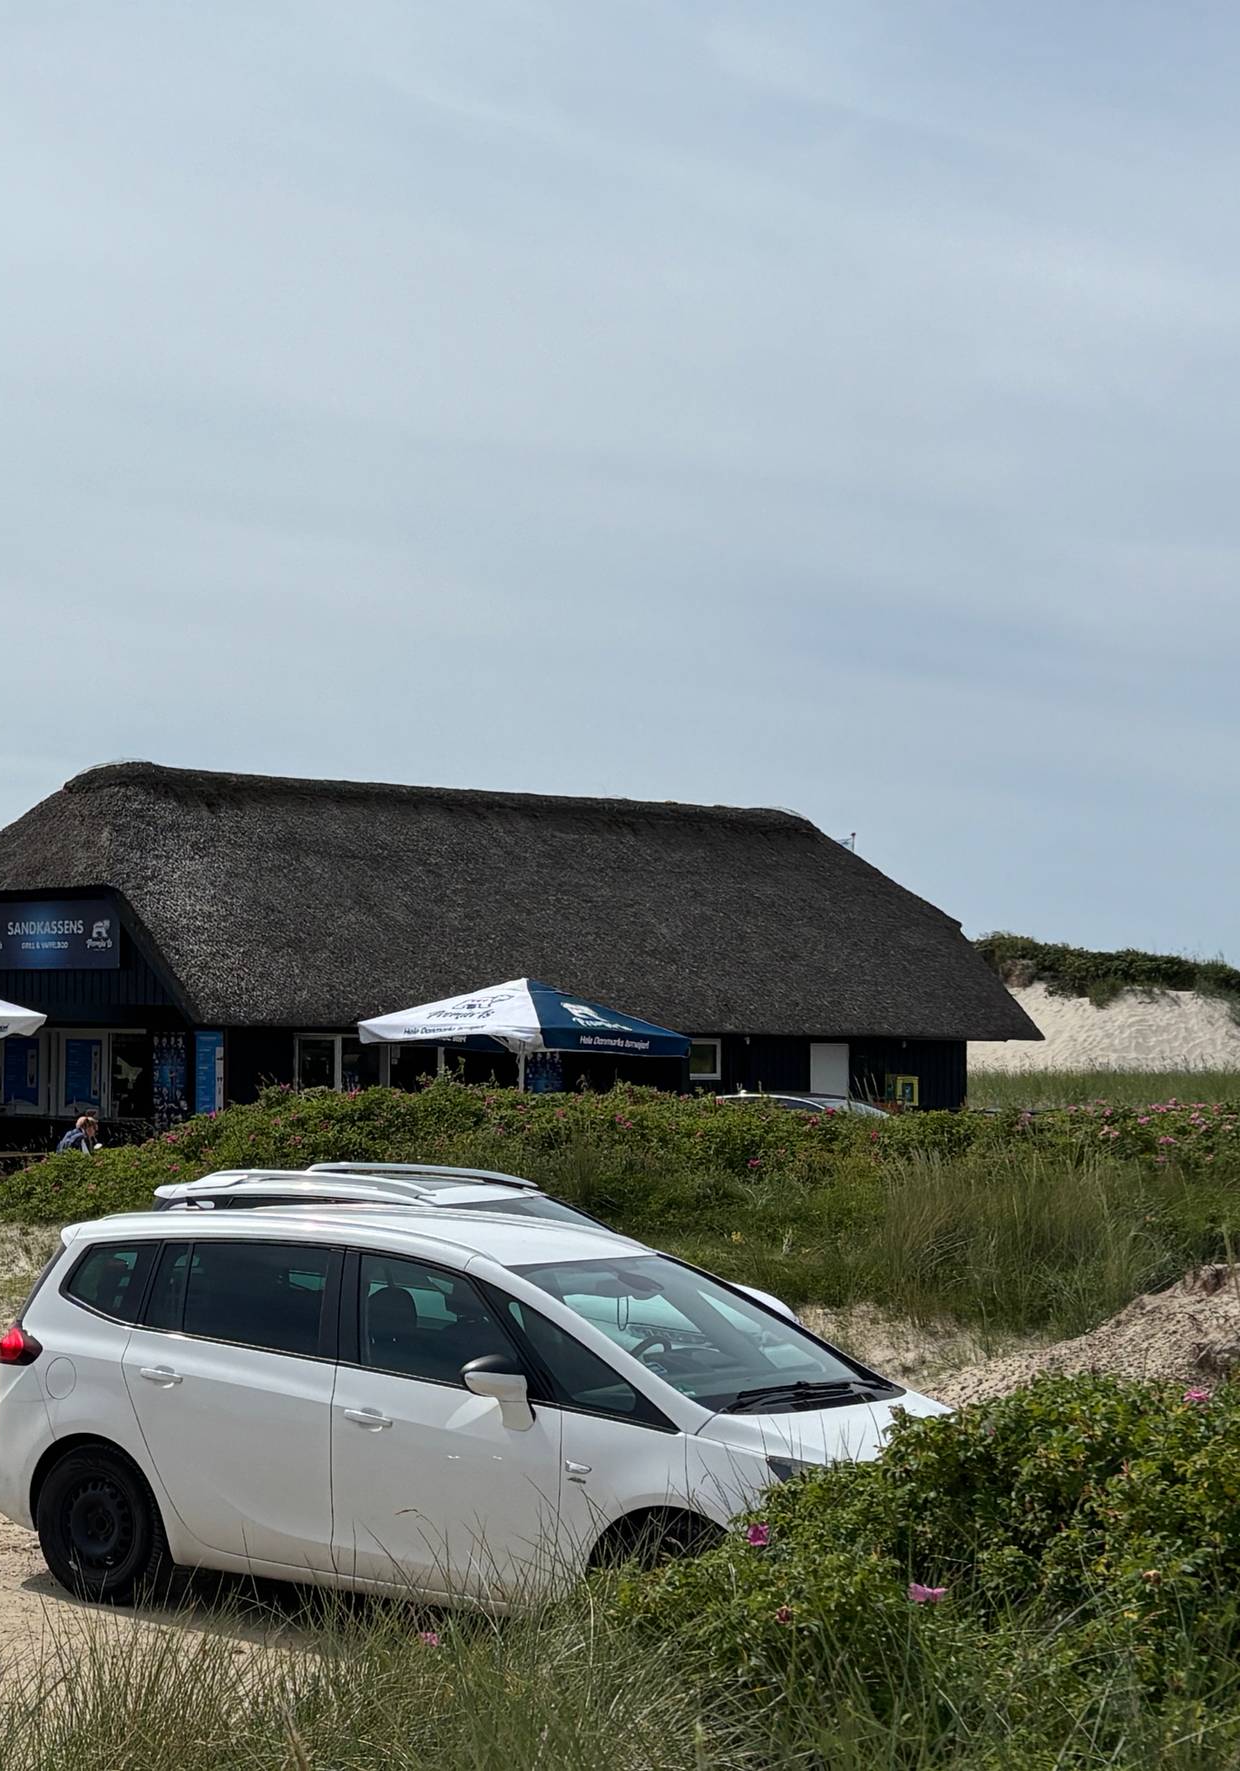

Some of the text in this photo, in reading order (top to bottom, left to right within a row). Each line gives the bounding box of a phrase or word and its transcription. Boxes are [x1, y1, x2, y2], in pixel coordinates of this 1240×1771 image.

[7, 919, 84, 936] SANDKASSENS
[579, 1035, 593, 1045] Hele
[594, 1036, 624, 1047] Danmarks
